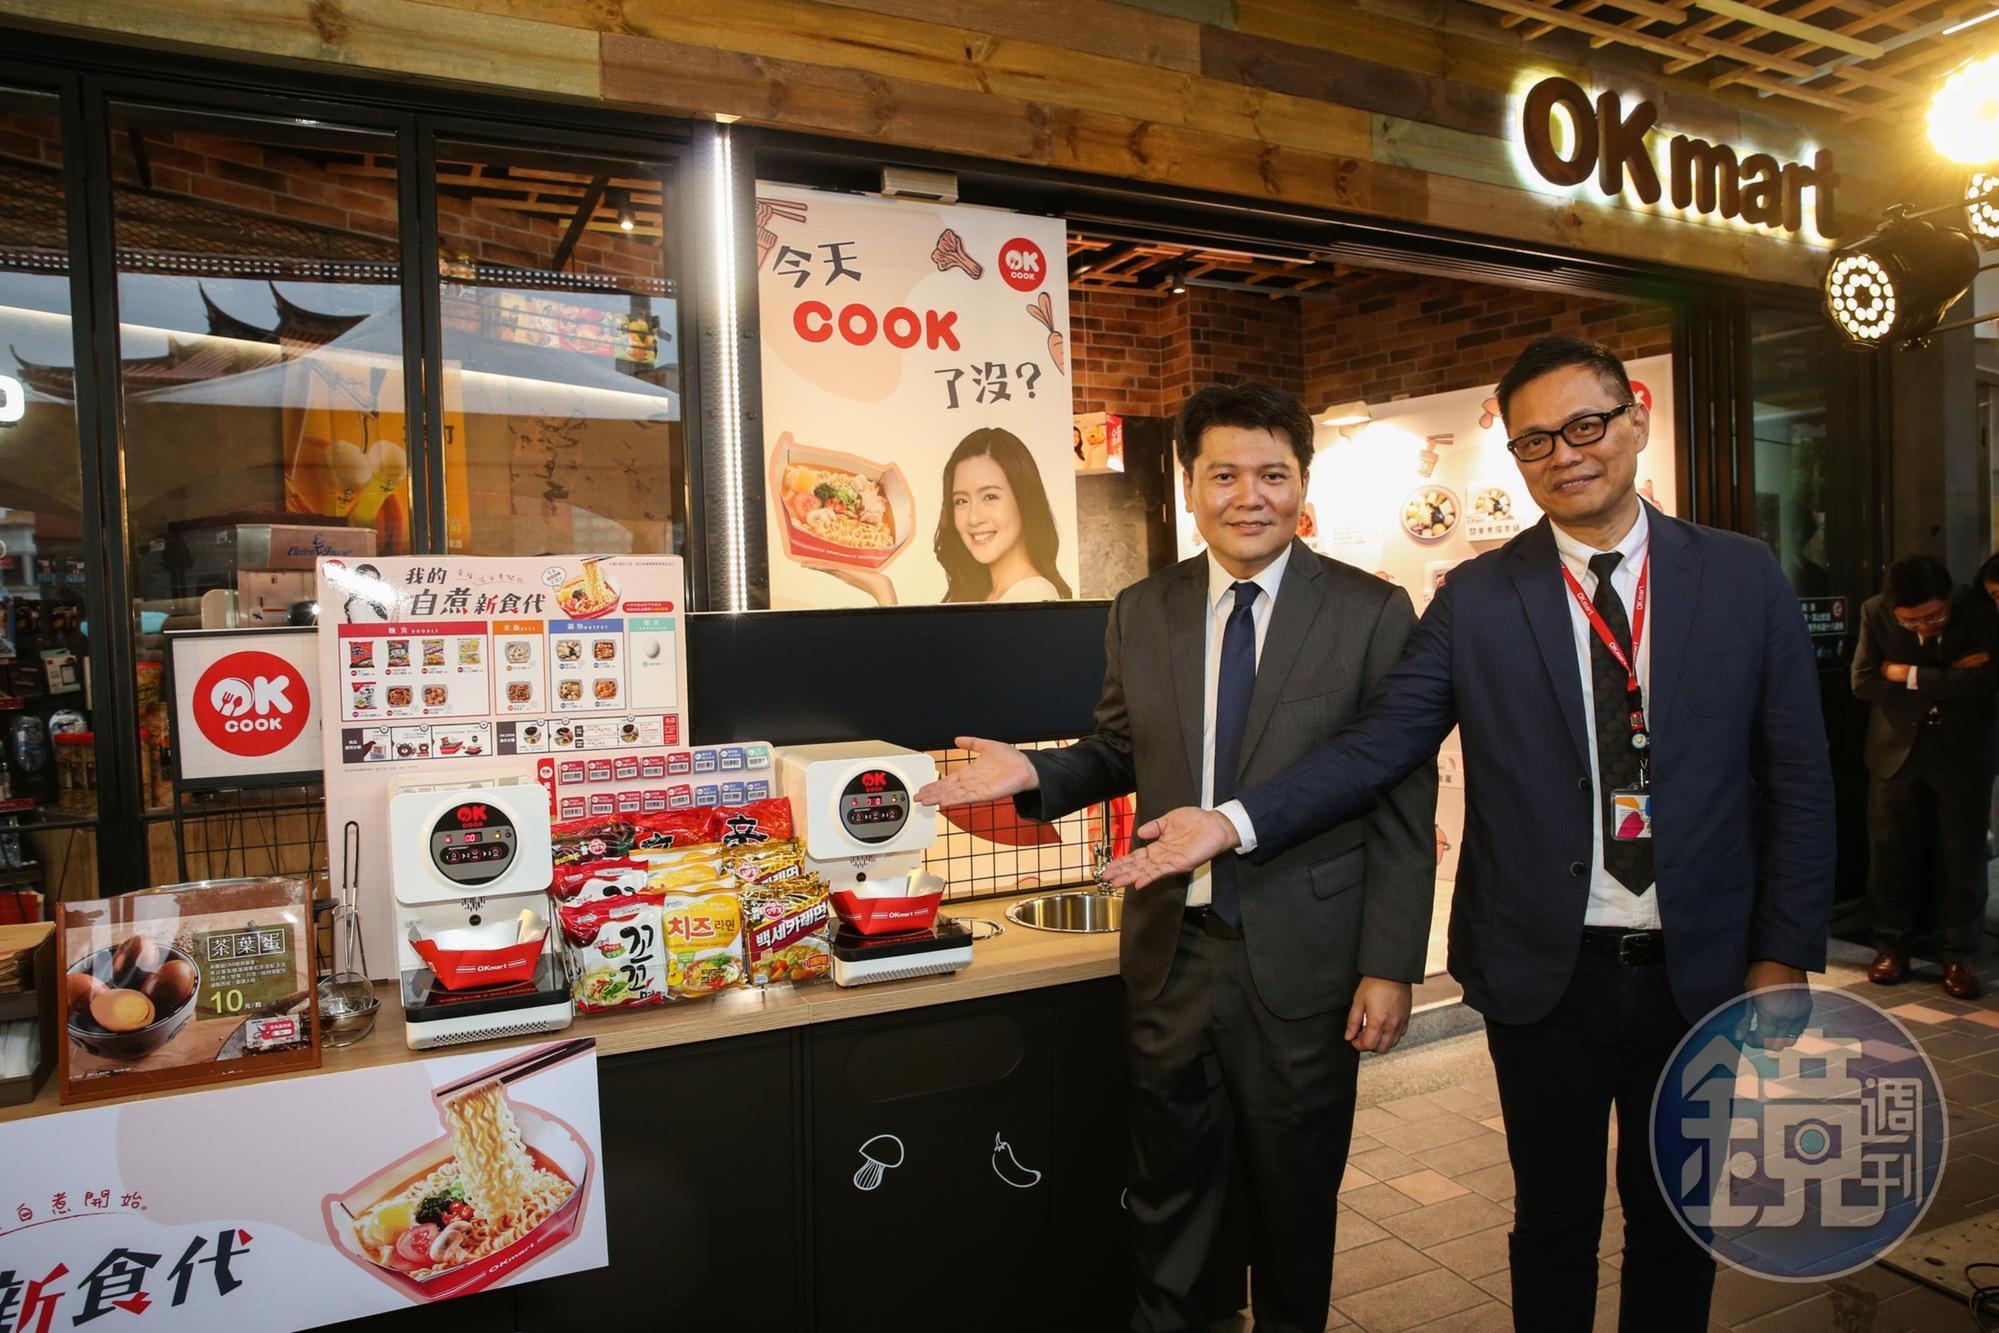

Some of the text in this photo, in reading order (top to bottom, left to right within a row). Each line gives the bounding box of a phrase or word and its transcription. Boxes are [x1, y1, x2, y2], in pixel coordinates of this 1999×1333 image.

[773, 241, 862, 288] 今天
[1005, 249, 1039, 273] OK
[1010, 271, 1035, 280] COOK
[793, 300, 960, 352] COOK
[934, 361, 1042, 410] 了沒?
[405, 567, 448, 585] 我的
[211, 675, 293, 718] OK
[224, 717, 283, 733] COOK
[862, 772, 887, 787] OK
[457, 805, 487, 822] OK
[667, 915, 716, 942] 치즈
[210, 932, 282, 956] 茶葉蛋
[477, 963, 508, 972] OKmart
[210, 989, 243, 1014] 10
[489, 1243, 535, 1273] OKmart
